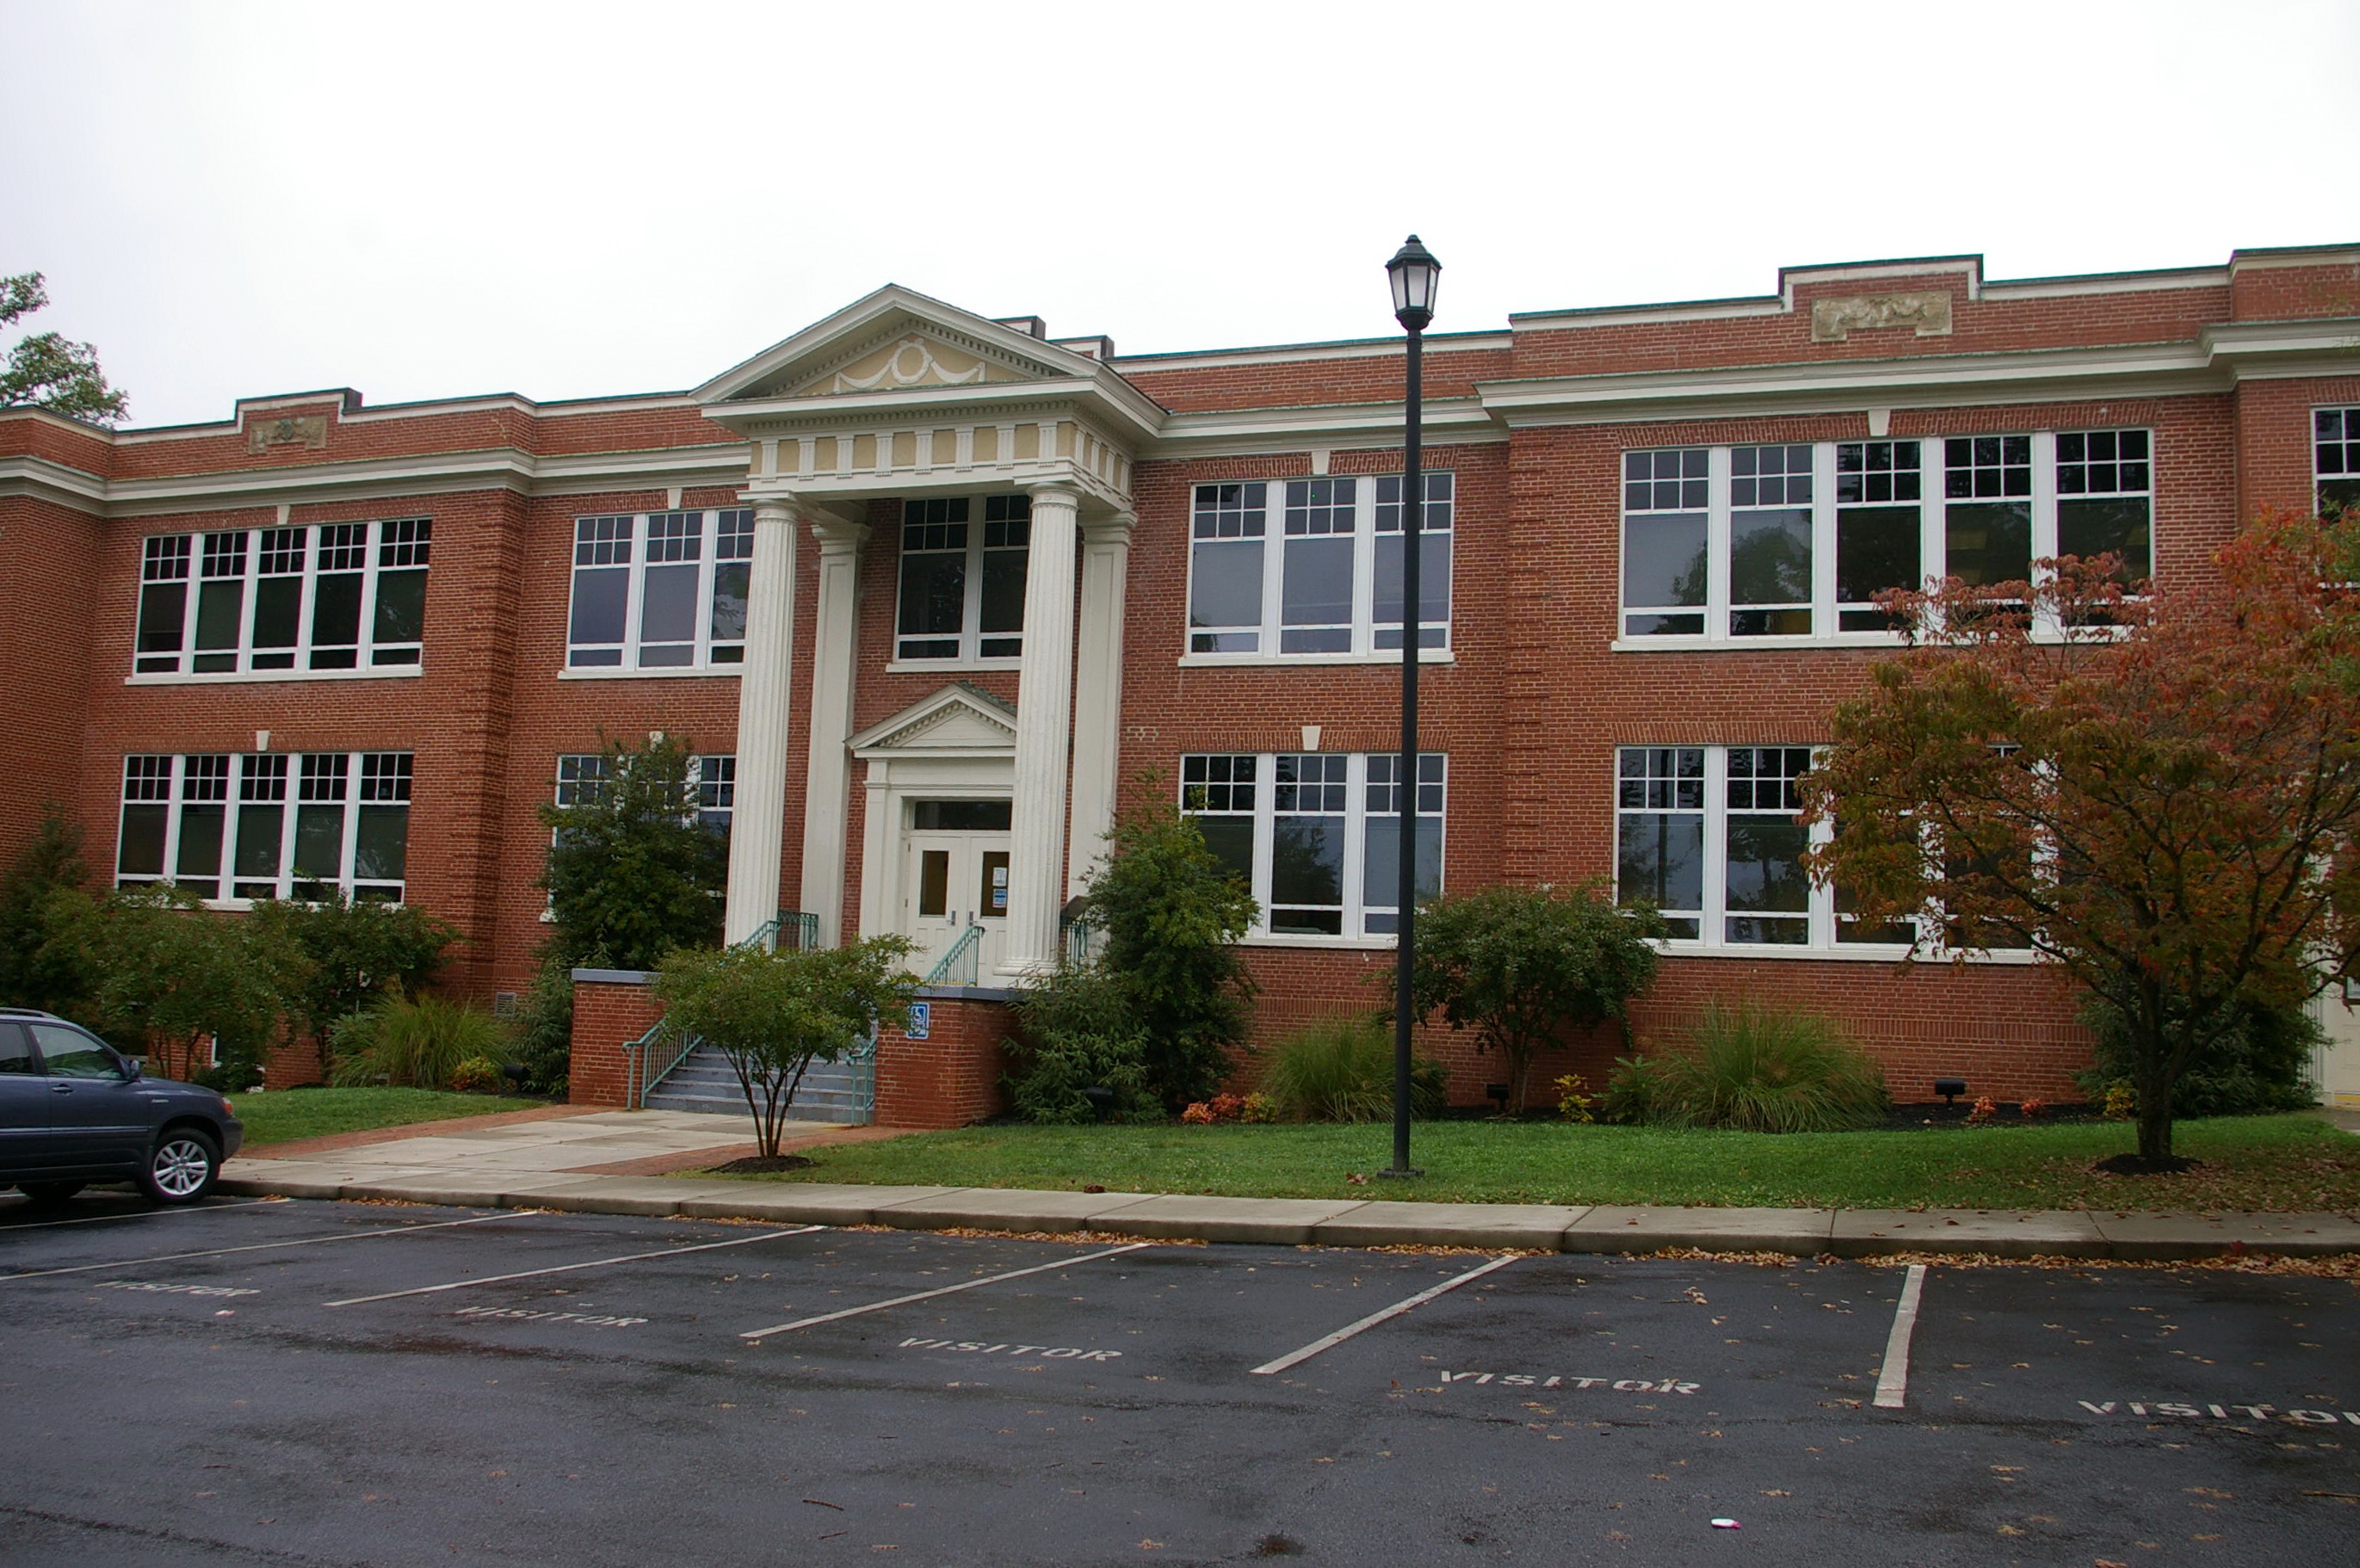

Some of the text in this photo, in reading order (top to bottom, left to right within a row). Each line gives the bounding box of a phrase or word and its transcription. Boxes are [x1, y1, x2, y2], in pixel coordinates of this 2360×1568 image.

[454, 1306, 649, 1327] VISITOR
[898, 1337, 1122, 1361] VISITOR
[1441, 1370, 1701, 1395] VISITOR
